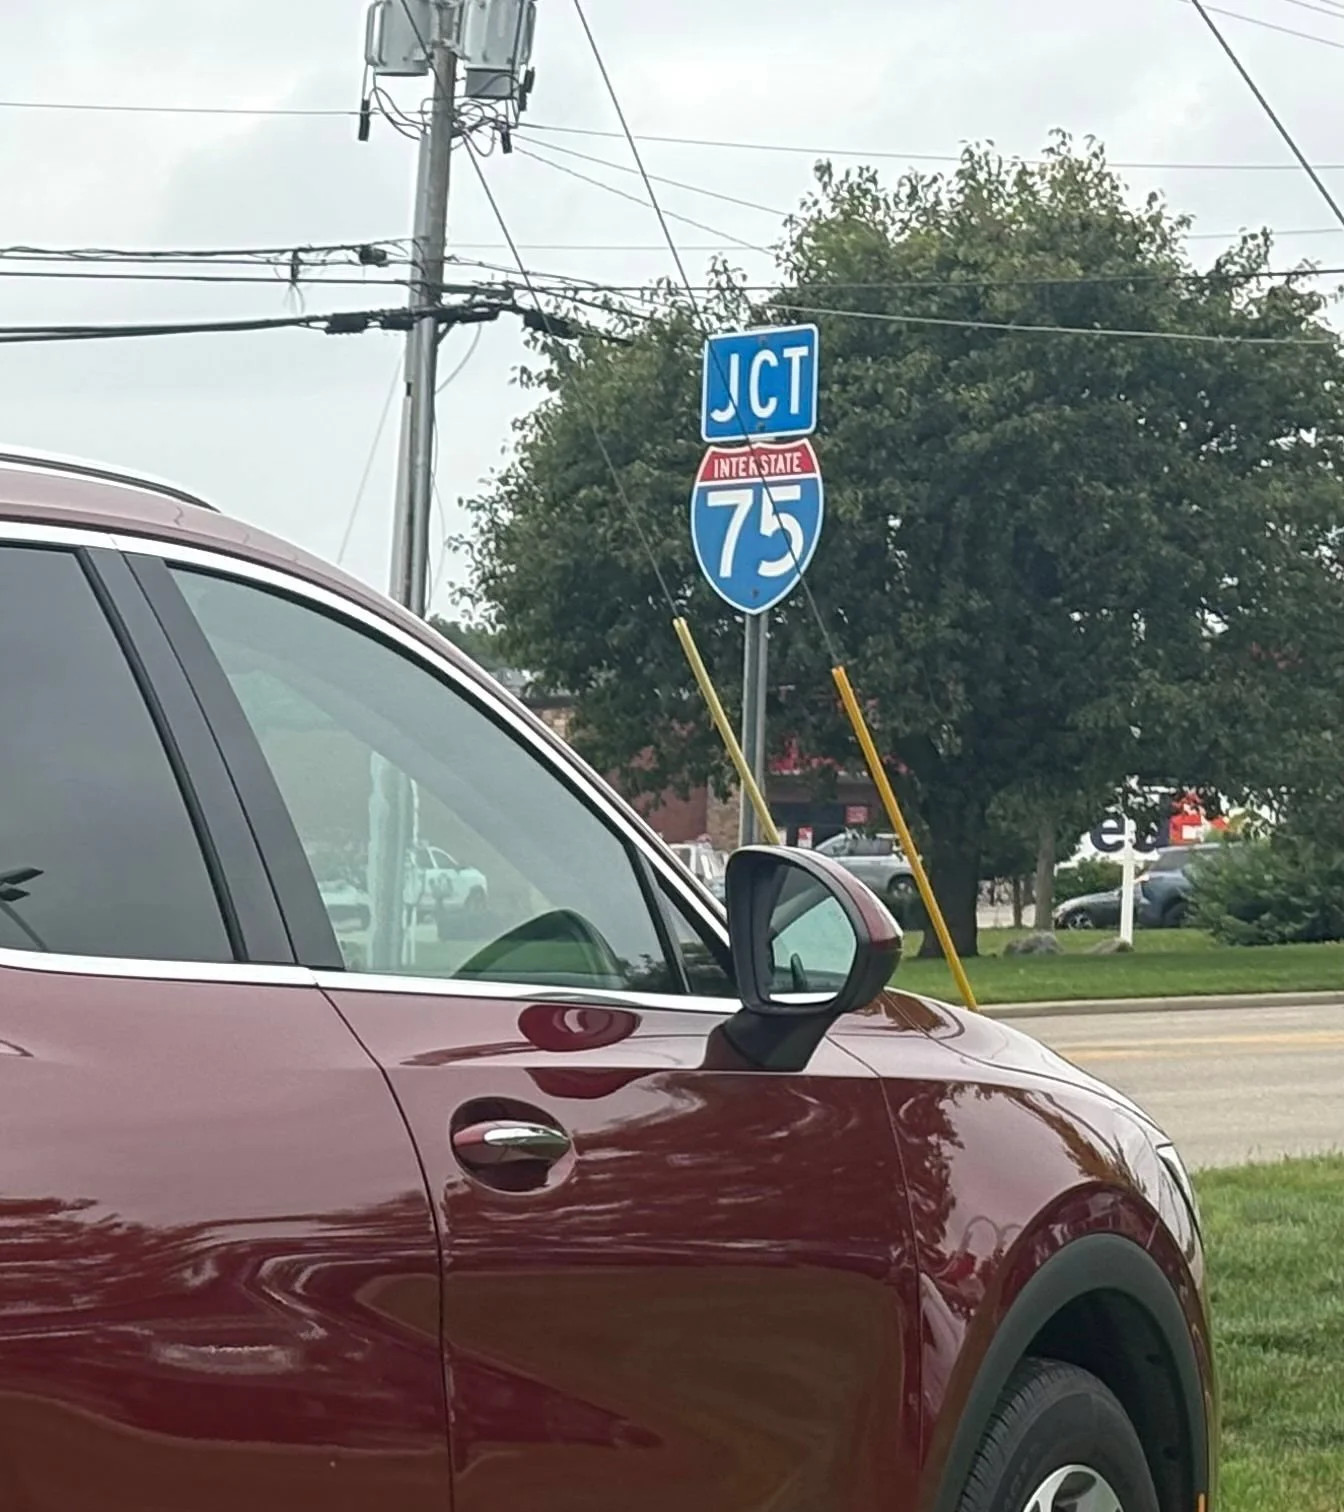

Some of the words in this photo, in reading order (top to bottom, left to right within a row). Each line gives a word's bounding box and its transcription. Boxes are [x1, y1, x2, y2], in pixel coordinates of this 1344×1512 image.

[710, 345, 809, 423] JCT
[713, 450, 803, 479] INTERSTATE
[707, 484, 805, 579] 75
